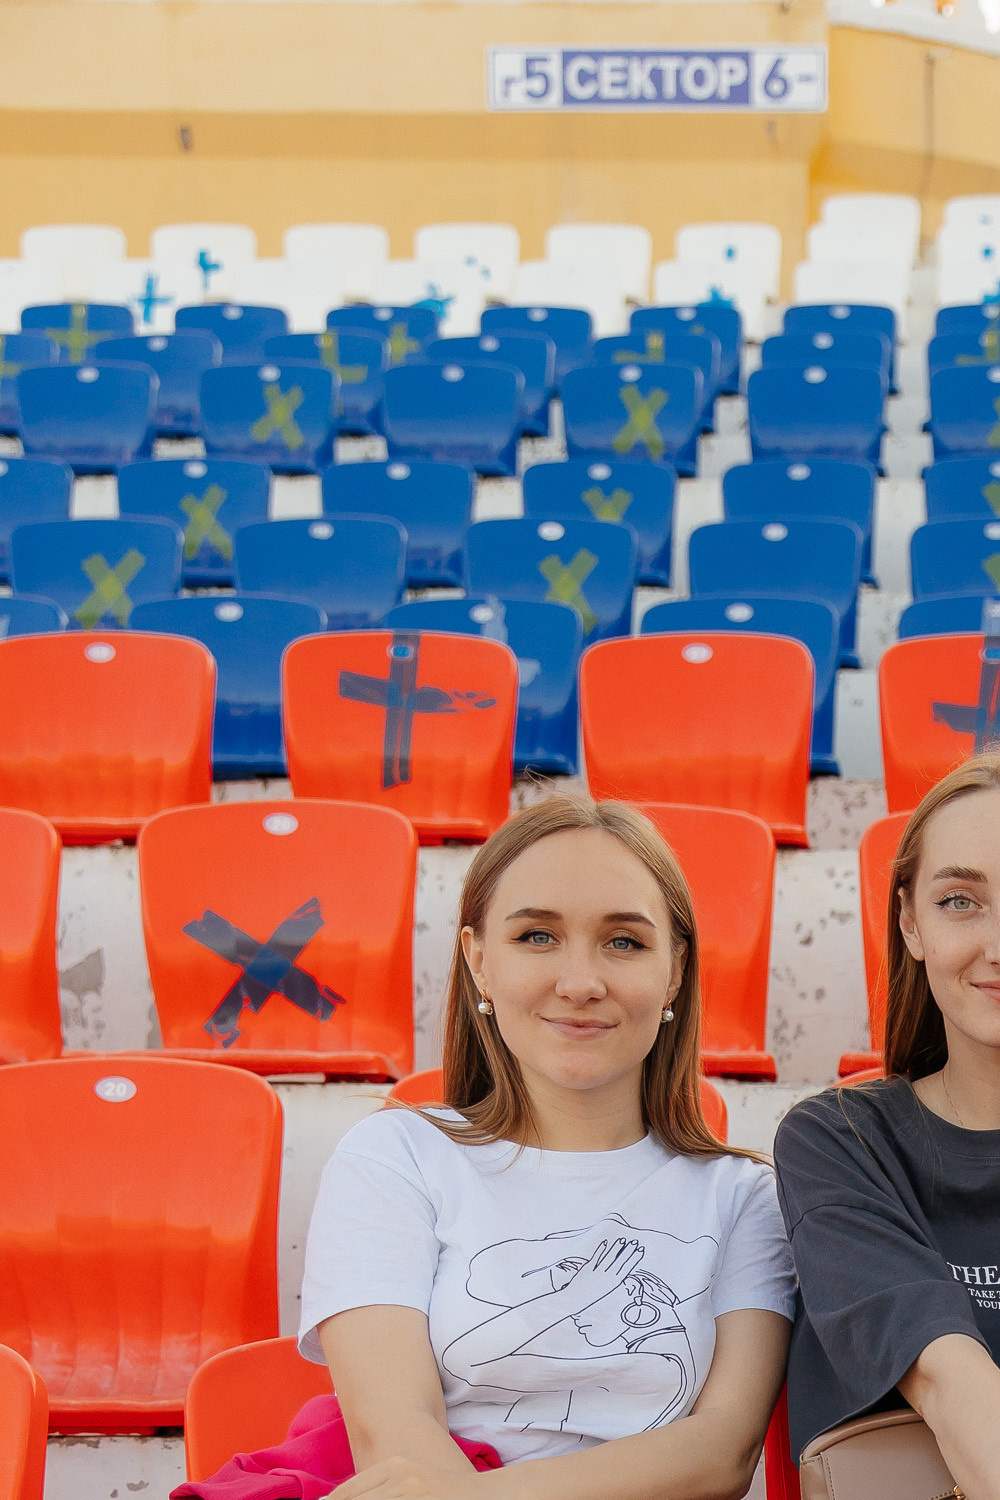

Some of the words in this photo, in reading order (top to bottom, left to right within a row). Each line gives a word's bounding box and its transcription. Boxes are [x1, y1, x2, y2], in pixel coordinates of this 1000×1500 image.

[563, 54, 749, 101] СЕКТОР
[104, 1081, 128, 1097] 20
[946, 1261, 1000, 1286] THE
[967, 1286, 996, 1299] TAKE
